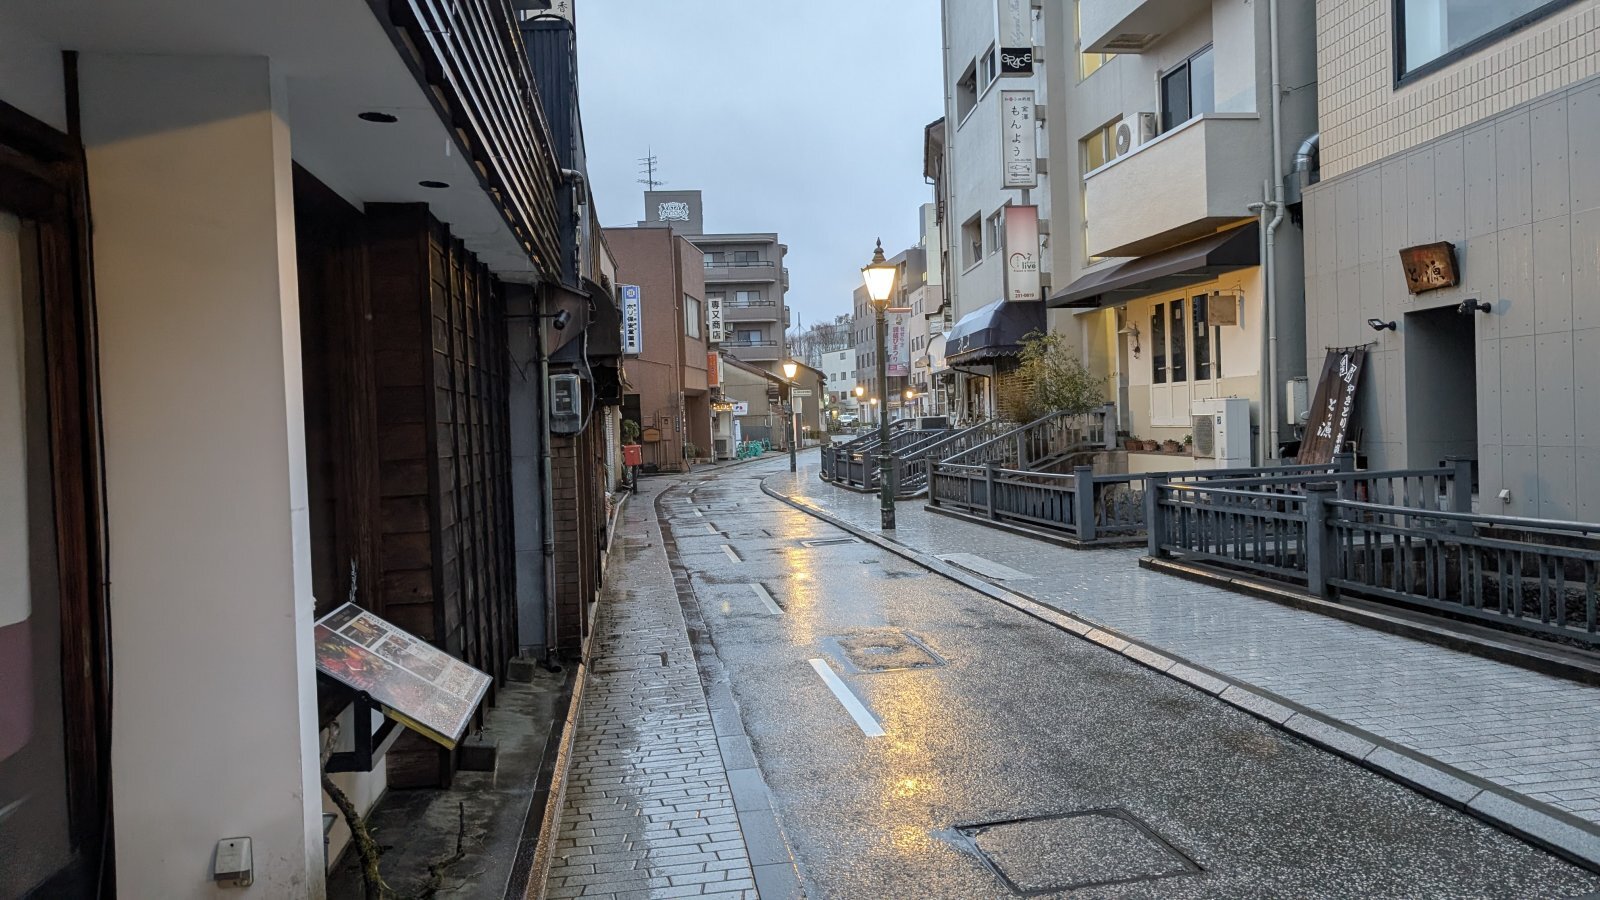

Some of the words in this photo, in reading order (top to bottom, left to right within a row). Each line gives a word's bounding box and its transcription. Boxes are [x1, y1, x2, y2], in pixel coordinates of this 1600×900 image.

[1001, 54, 1032, 68] GRACE
[1010, 105, 1021, 157] もんよう
